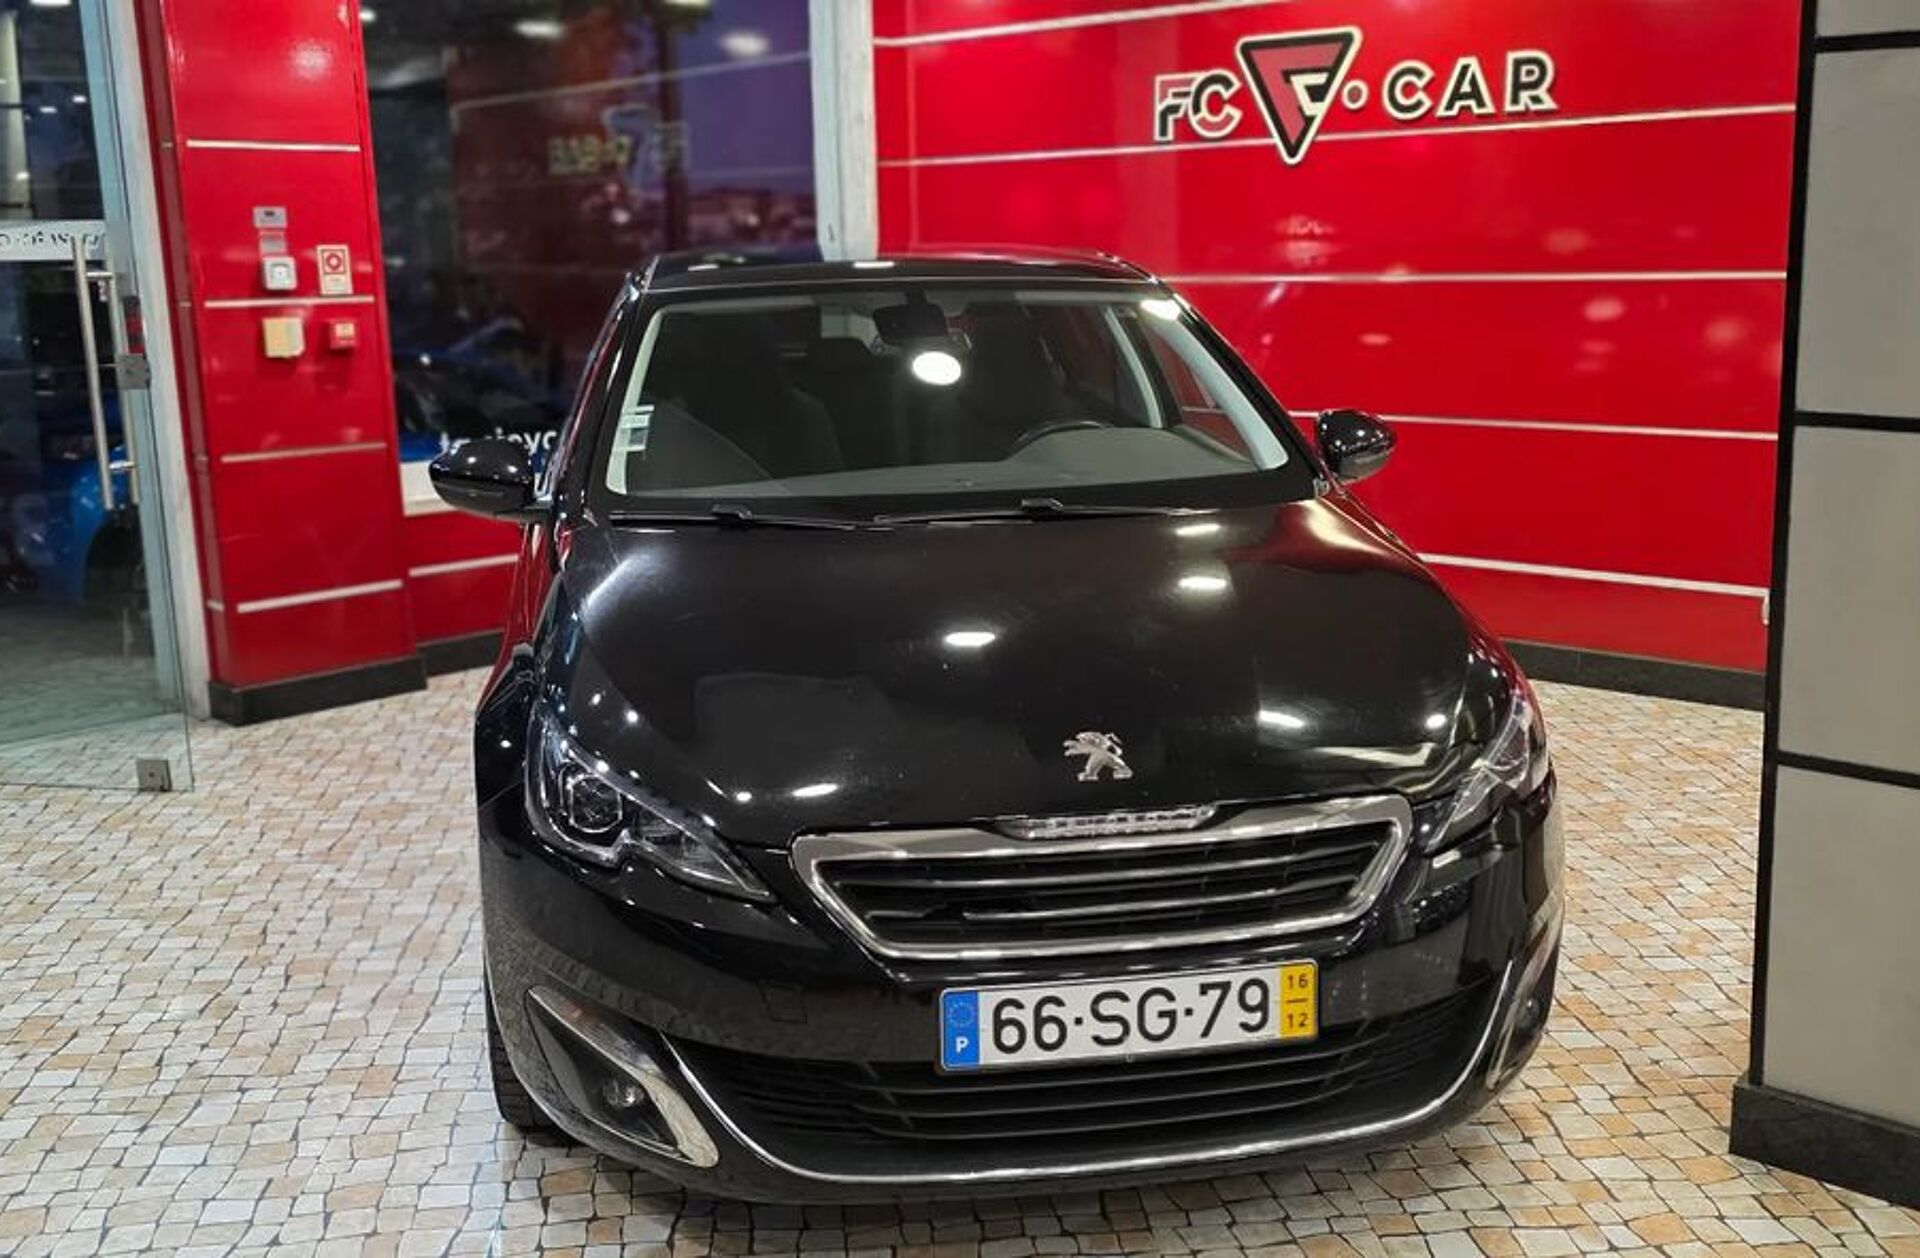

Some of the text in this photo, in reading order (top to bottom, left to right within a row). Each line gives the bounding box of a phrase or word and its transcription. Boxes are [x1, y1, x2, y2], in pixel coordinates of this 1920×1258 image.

[1382, 50, 1558, 120] CAR
[1286, 973, 1309, 990] 16
[1286, 1013, 1309, 1030] 12
[955, 1037, 969, 1054] P
